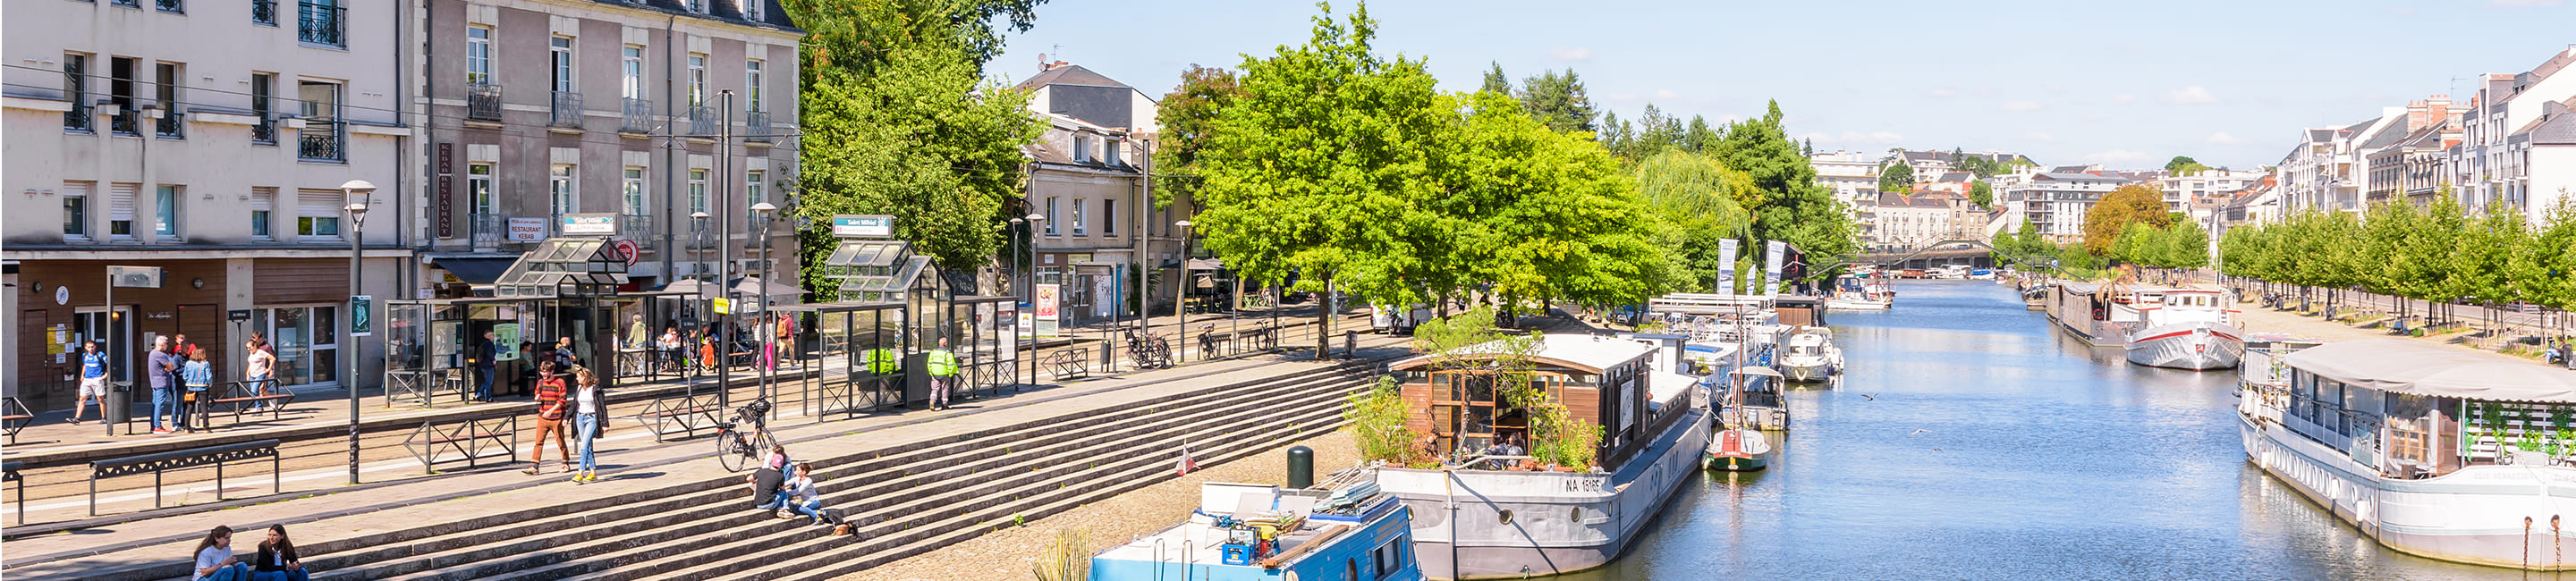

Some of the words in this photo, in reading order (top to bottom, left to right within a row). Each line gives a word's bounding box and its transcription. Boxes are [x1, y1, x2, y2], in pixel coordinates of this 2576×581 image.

[441, 144, 449, 173] KEBAB
[441, 177, 449, 234] RESTAURANT
[745, 260, 772, 270] IMMOER
[1566, 479, 1579, 493] NA
